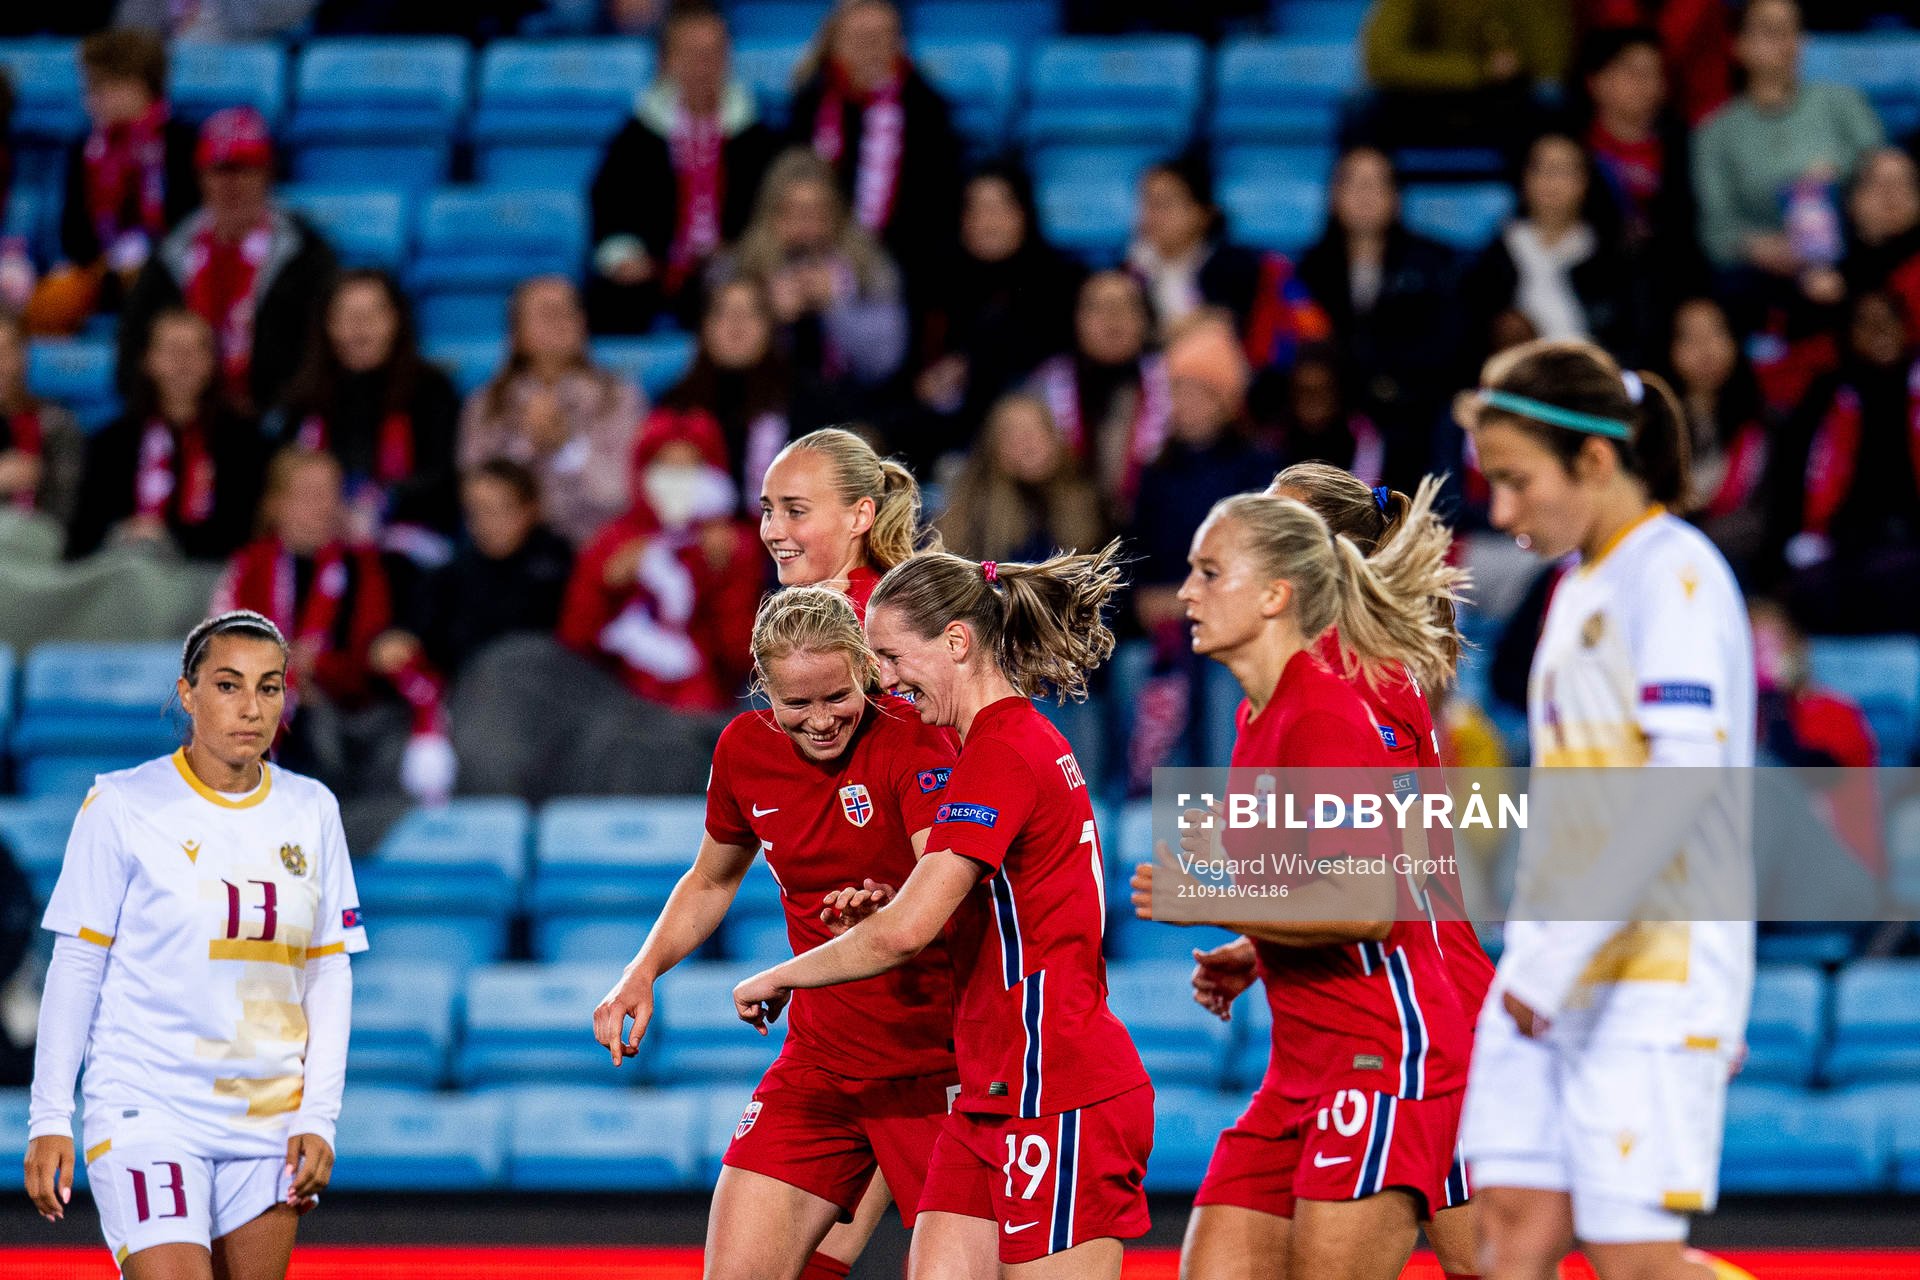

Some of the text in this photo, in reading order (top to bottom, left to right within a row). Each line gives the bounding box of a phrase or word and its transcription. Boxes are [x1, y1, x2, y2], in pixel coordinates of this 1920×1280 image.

[950, 808, 997, 823] RESPECT
[221, 878, 278, 942] 13
[126, 1161, 188, 1224] 13
[1002, 1134, 1051, 1200] 19
